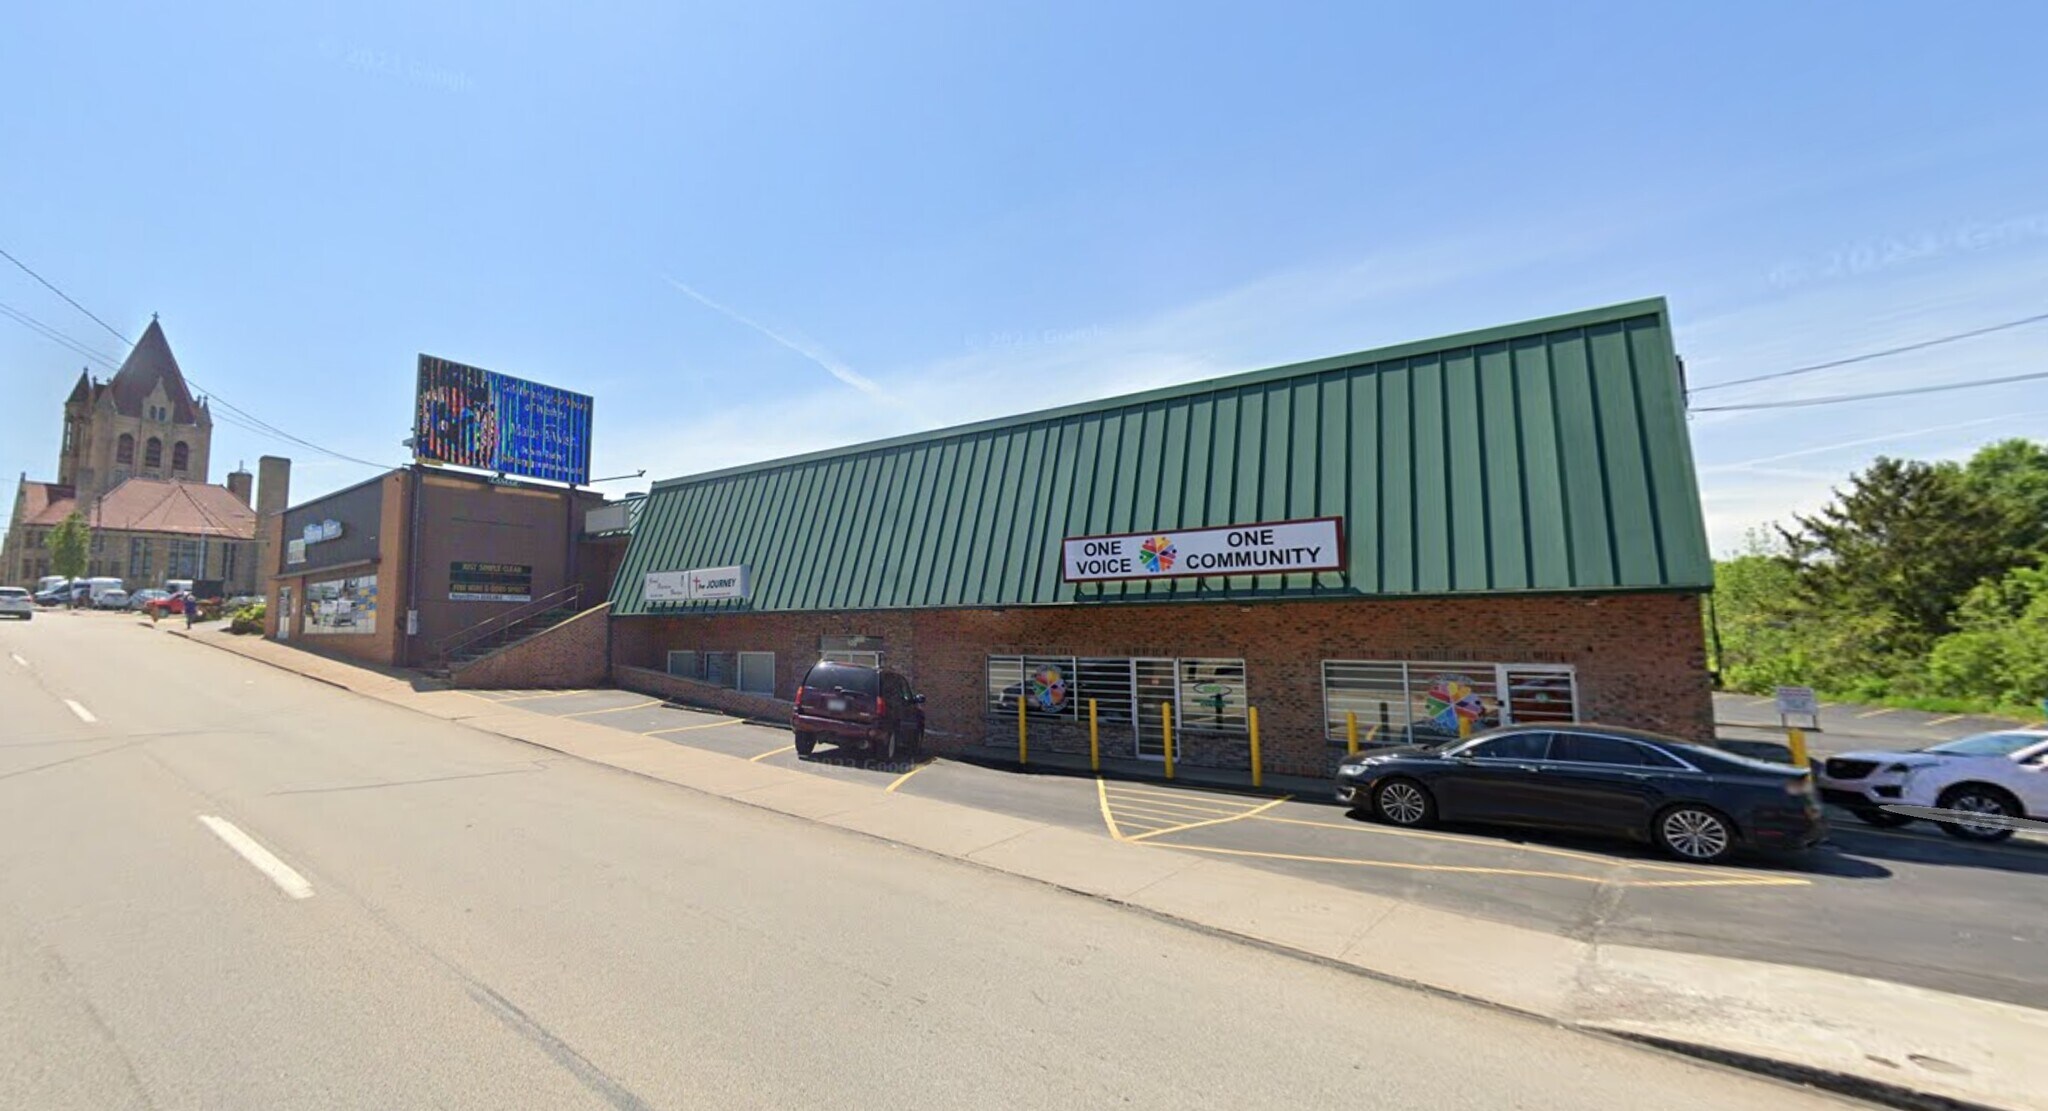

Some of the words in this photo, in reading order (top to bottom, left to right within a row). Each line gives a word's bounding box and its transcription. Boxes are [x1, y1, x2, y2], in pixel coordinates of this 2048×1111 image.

[1227, 528, 1274, 548] ONE
[1084, 540, 1122, 556] ONE
[1076, 558, 1132, 575] VOICE
[1186, 546, 1321, 570] COMMUNITY
[706, 577, 736, 589] JOURNEY
